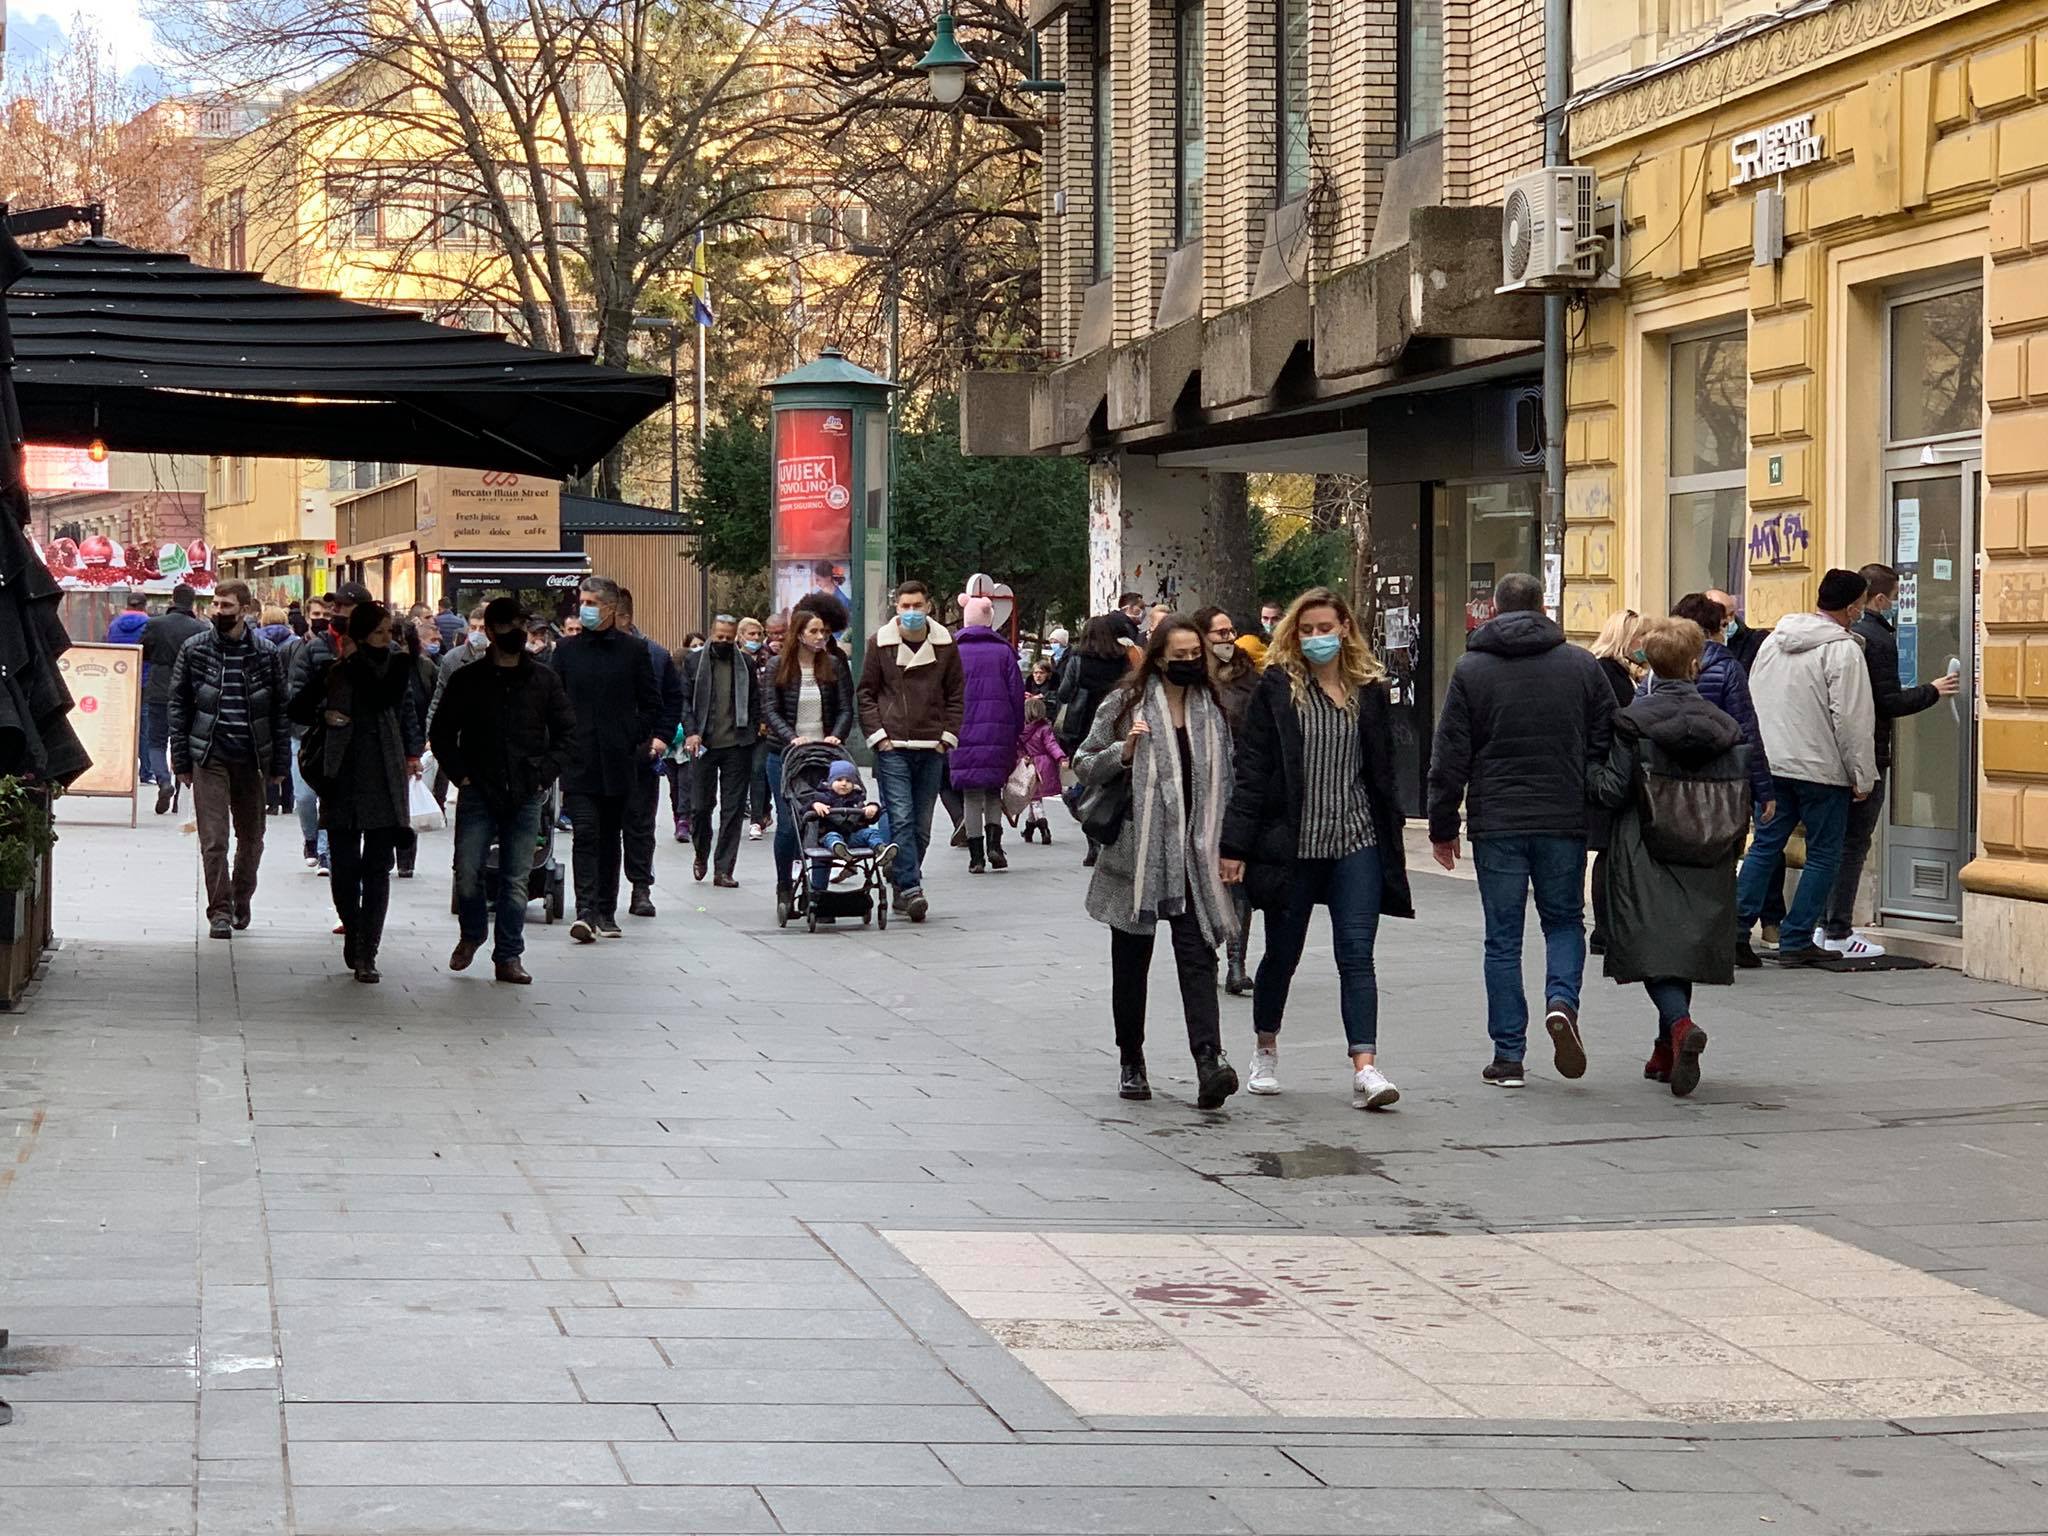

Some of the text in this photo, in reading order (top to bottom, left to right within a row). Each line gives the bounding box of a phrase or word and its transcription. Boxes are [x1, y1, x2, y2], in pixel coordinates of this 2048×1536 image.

[1766, 113, 1814, 150] SPORT
[1766, 135, 1824, 175] REALITY
[780, 462, 827, 482] UVIJEK
[452, 488, 549, 498] Mercato Main Street
[480, 513, 500, 523] juice
[516, 513, 539, 521] snack
[453, 527, 480, 538] gelato
[489, 527, 511, 536] dolce
